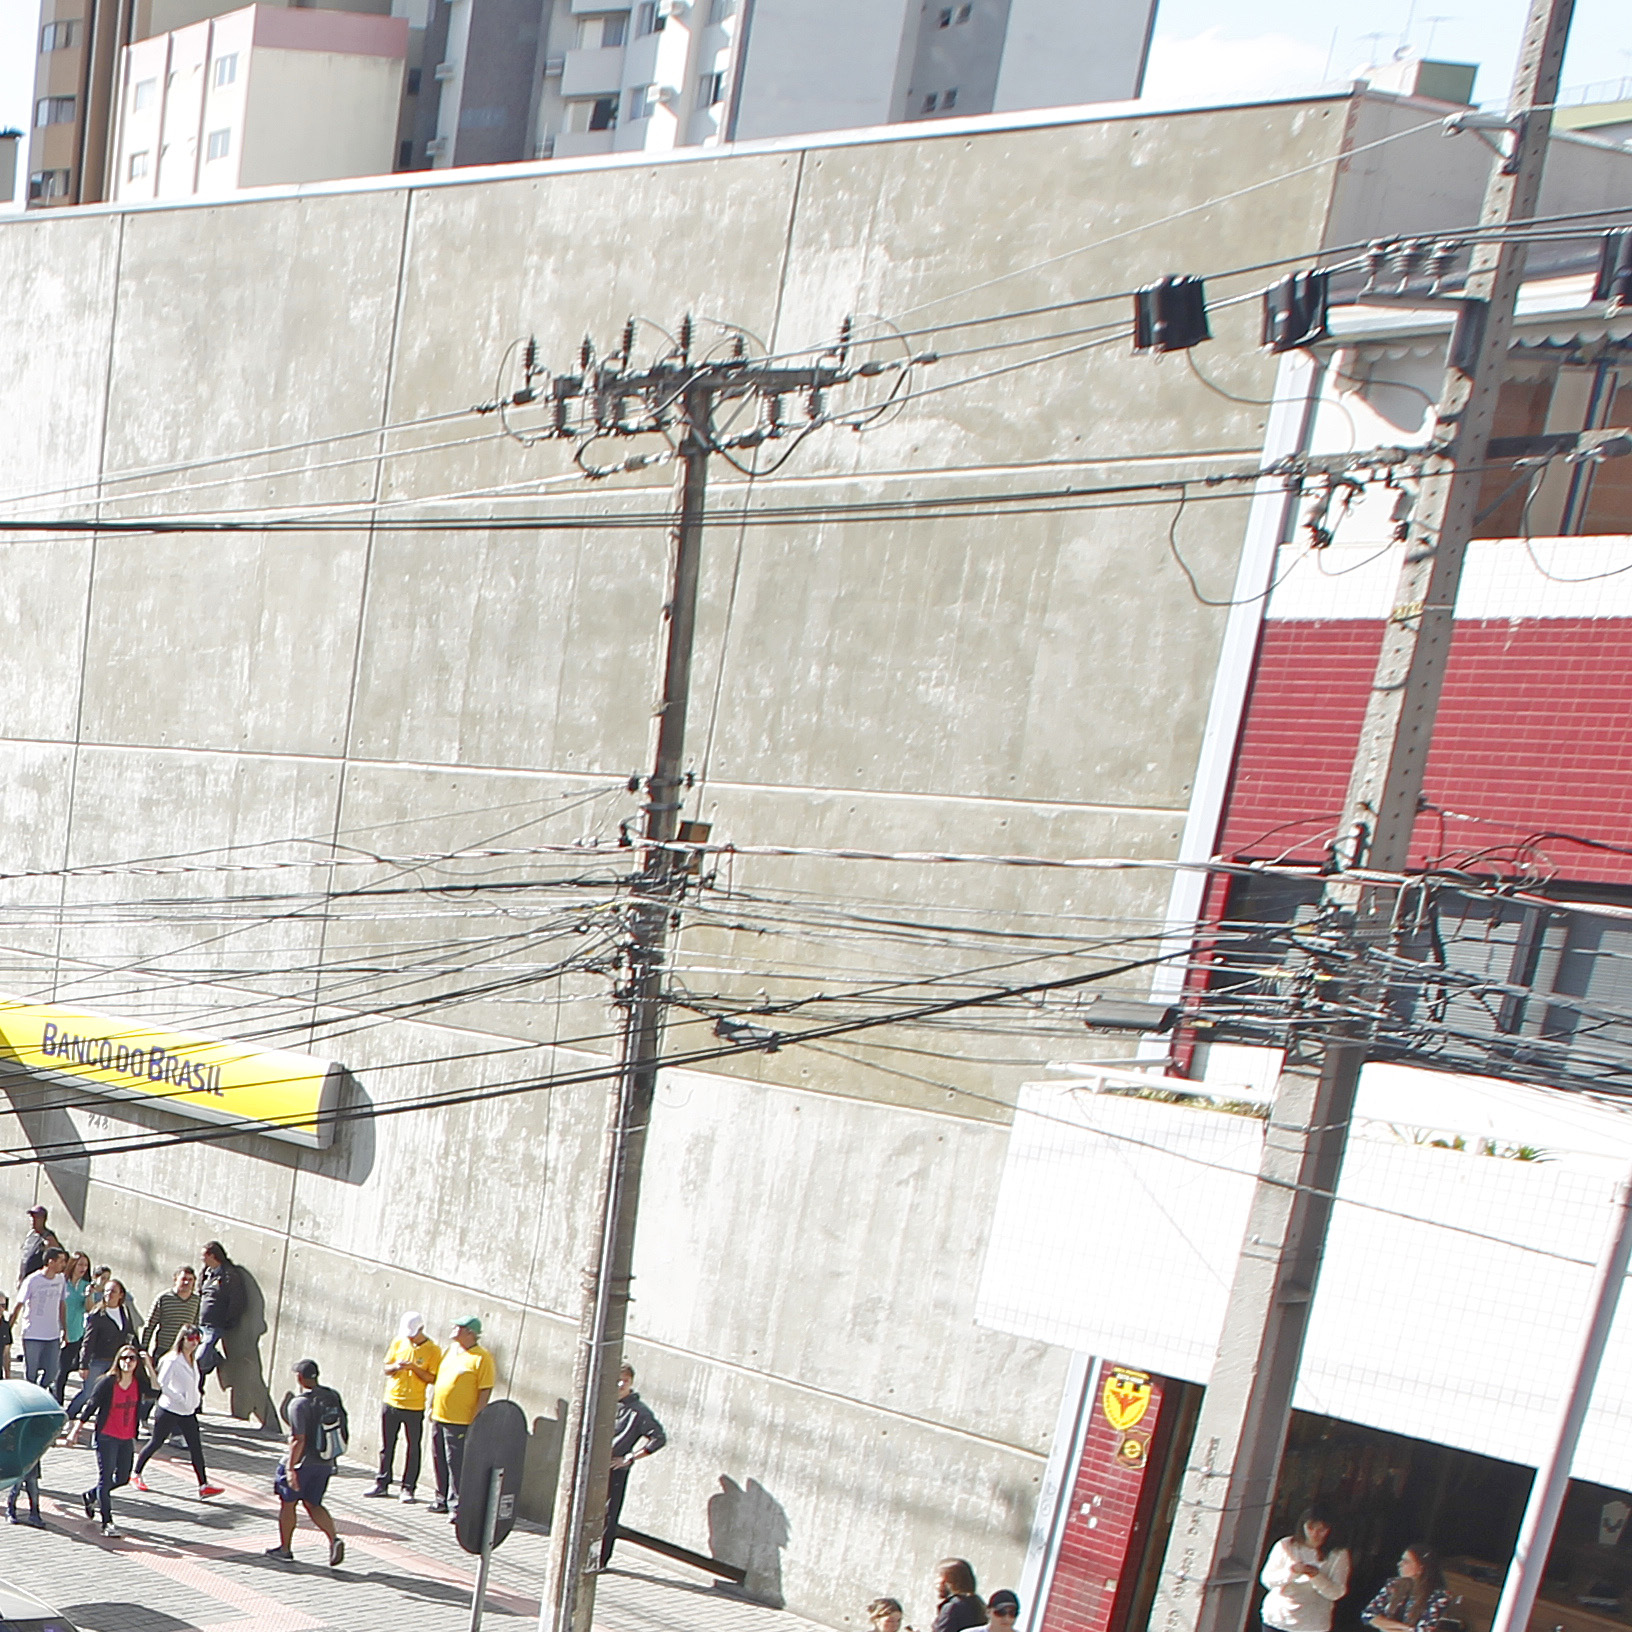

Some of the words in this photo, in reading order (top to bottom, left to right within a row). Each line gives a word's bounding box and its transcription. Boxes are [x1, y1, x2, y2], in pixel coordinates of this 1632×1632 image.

[42, 1022, 113, 1070] BANCO
[115, 1044, 145, 1078] DO
[147, 1045, 225, 1098] BRASIL
